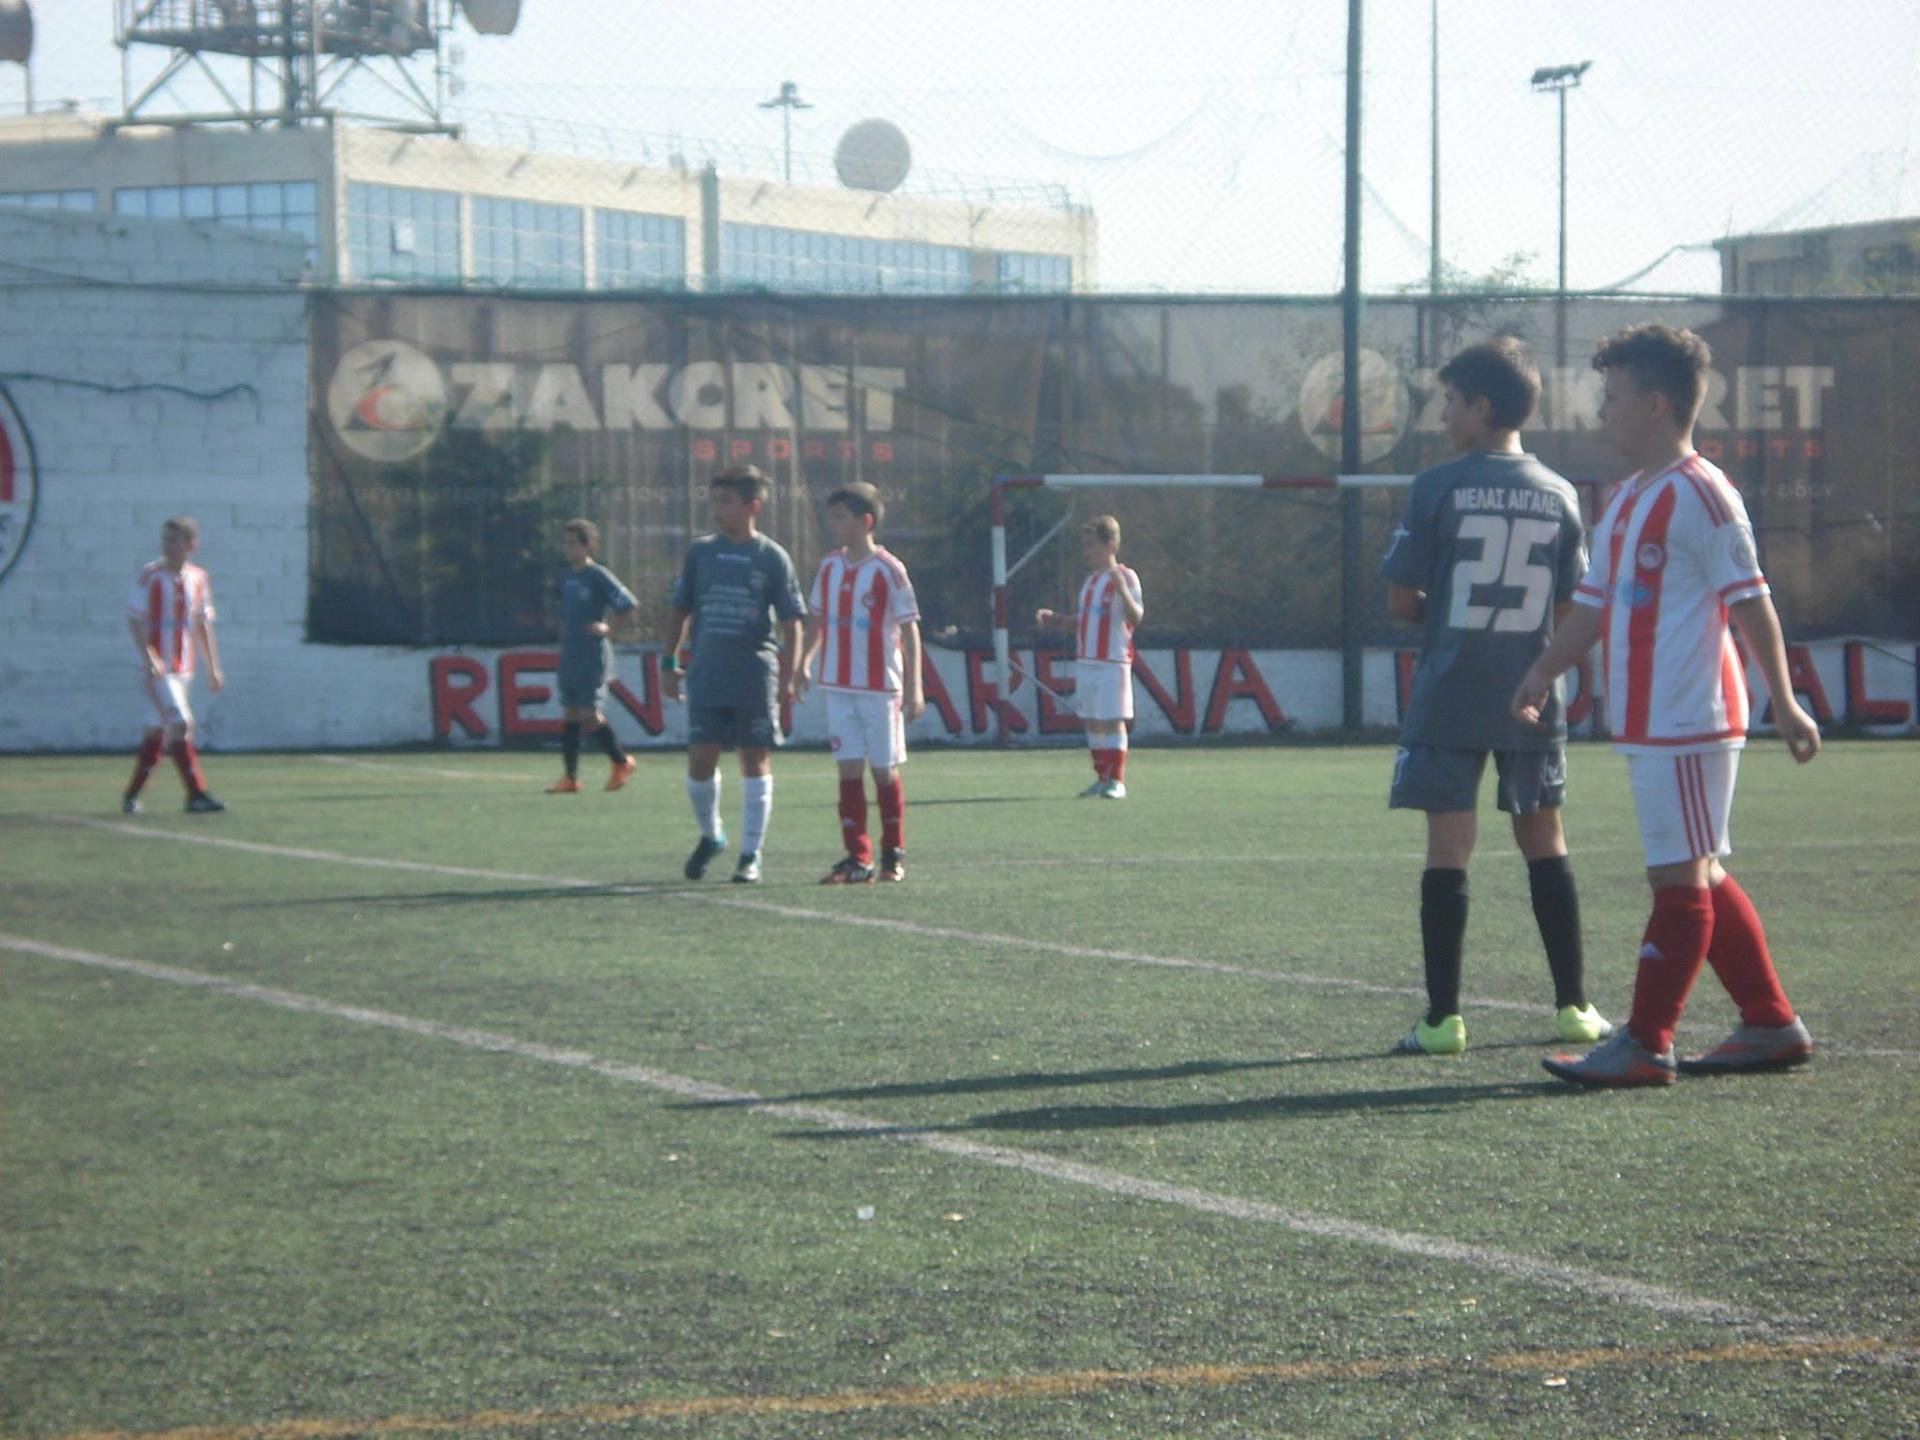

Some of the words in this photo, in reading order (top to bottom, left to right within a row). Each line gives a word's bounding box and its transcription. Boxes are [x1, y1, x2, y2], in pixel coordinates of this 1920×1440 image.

[451, 361, 906, 431] ZAKCRET
[692, 440, 894, 462] SPORTS
[1448, 514, 1560, 632] 25
